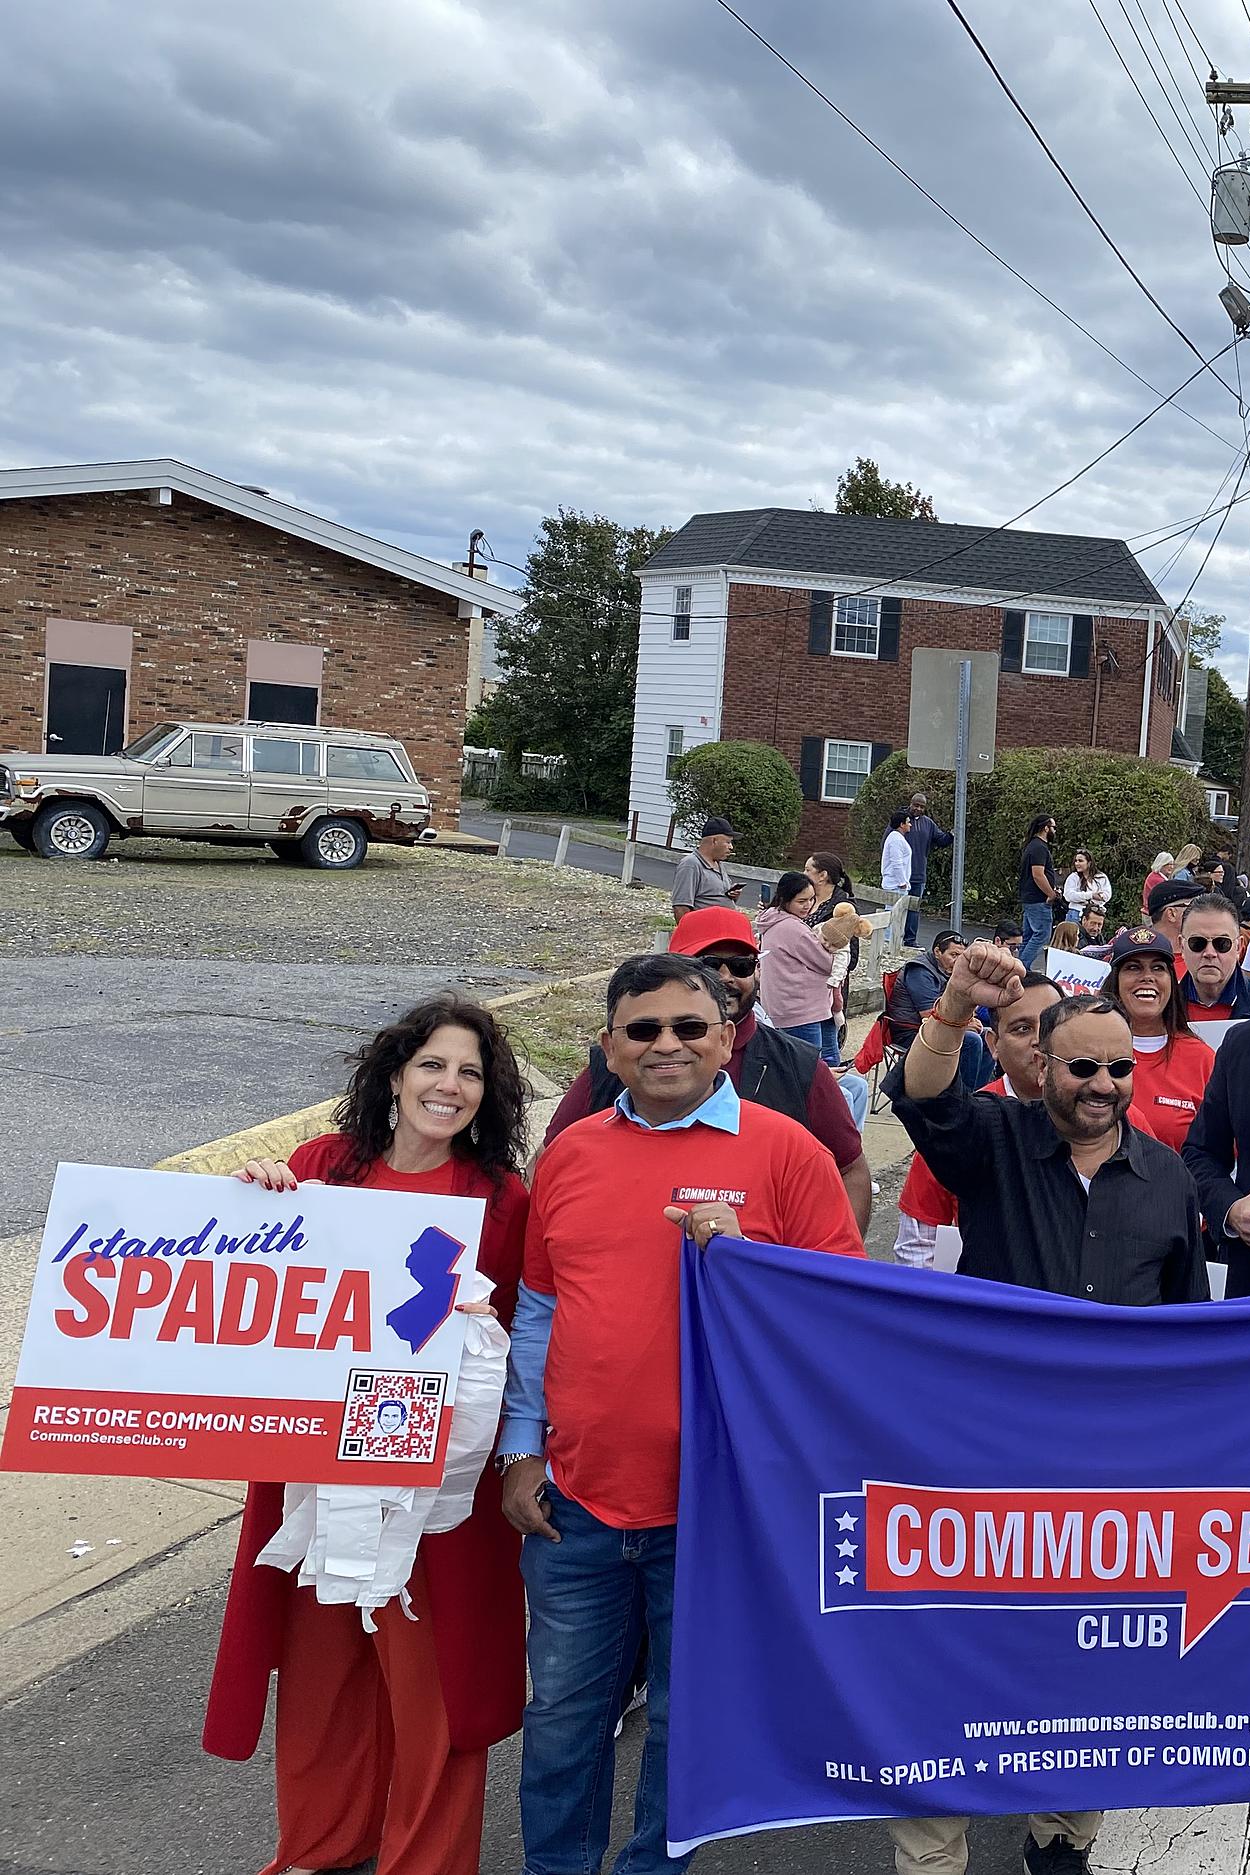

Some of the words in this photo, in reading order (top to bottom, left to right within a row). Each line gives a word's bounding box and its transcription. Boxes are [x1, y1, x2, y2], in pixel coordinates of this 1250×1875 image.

[679, 1187, 718, 1200] COMMON
[718, 1190, 746, 1204] SENSE
[51, 1223, 88, 1263] I
[83, 1217, 218, 1262] stand
[214, 1215, 309, 1255] with
[54, 1252, 372, 1352] SPADEA
[33, 1405, 142, 1428] RESTORE
[145, 1411, 244, 1432] COMMON
[250, 1415, 328, 1435] SENSE.
[30, 1429, 187, 1449] CommonSenseClub.org
[884, 1503, 1173, 1580] COMMON
[1077, 1614, 1168, 1650] CLUB
[825, 1761, 873, 1783] BILL
[879, 1757, 966, 1786] SPADEA
[998, 1748, 1121, 1774] PRESIDENT
[1127, 1747, 1155, 1766] OF
